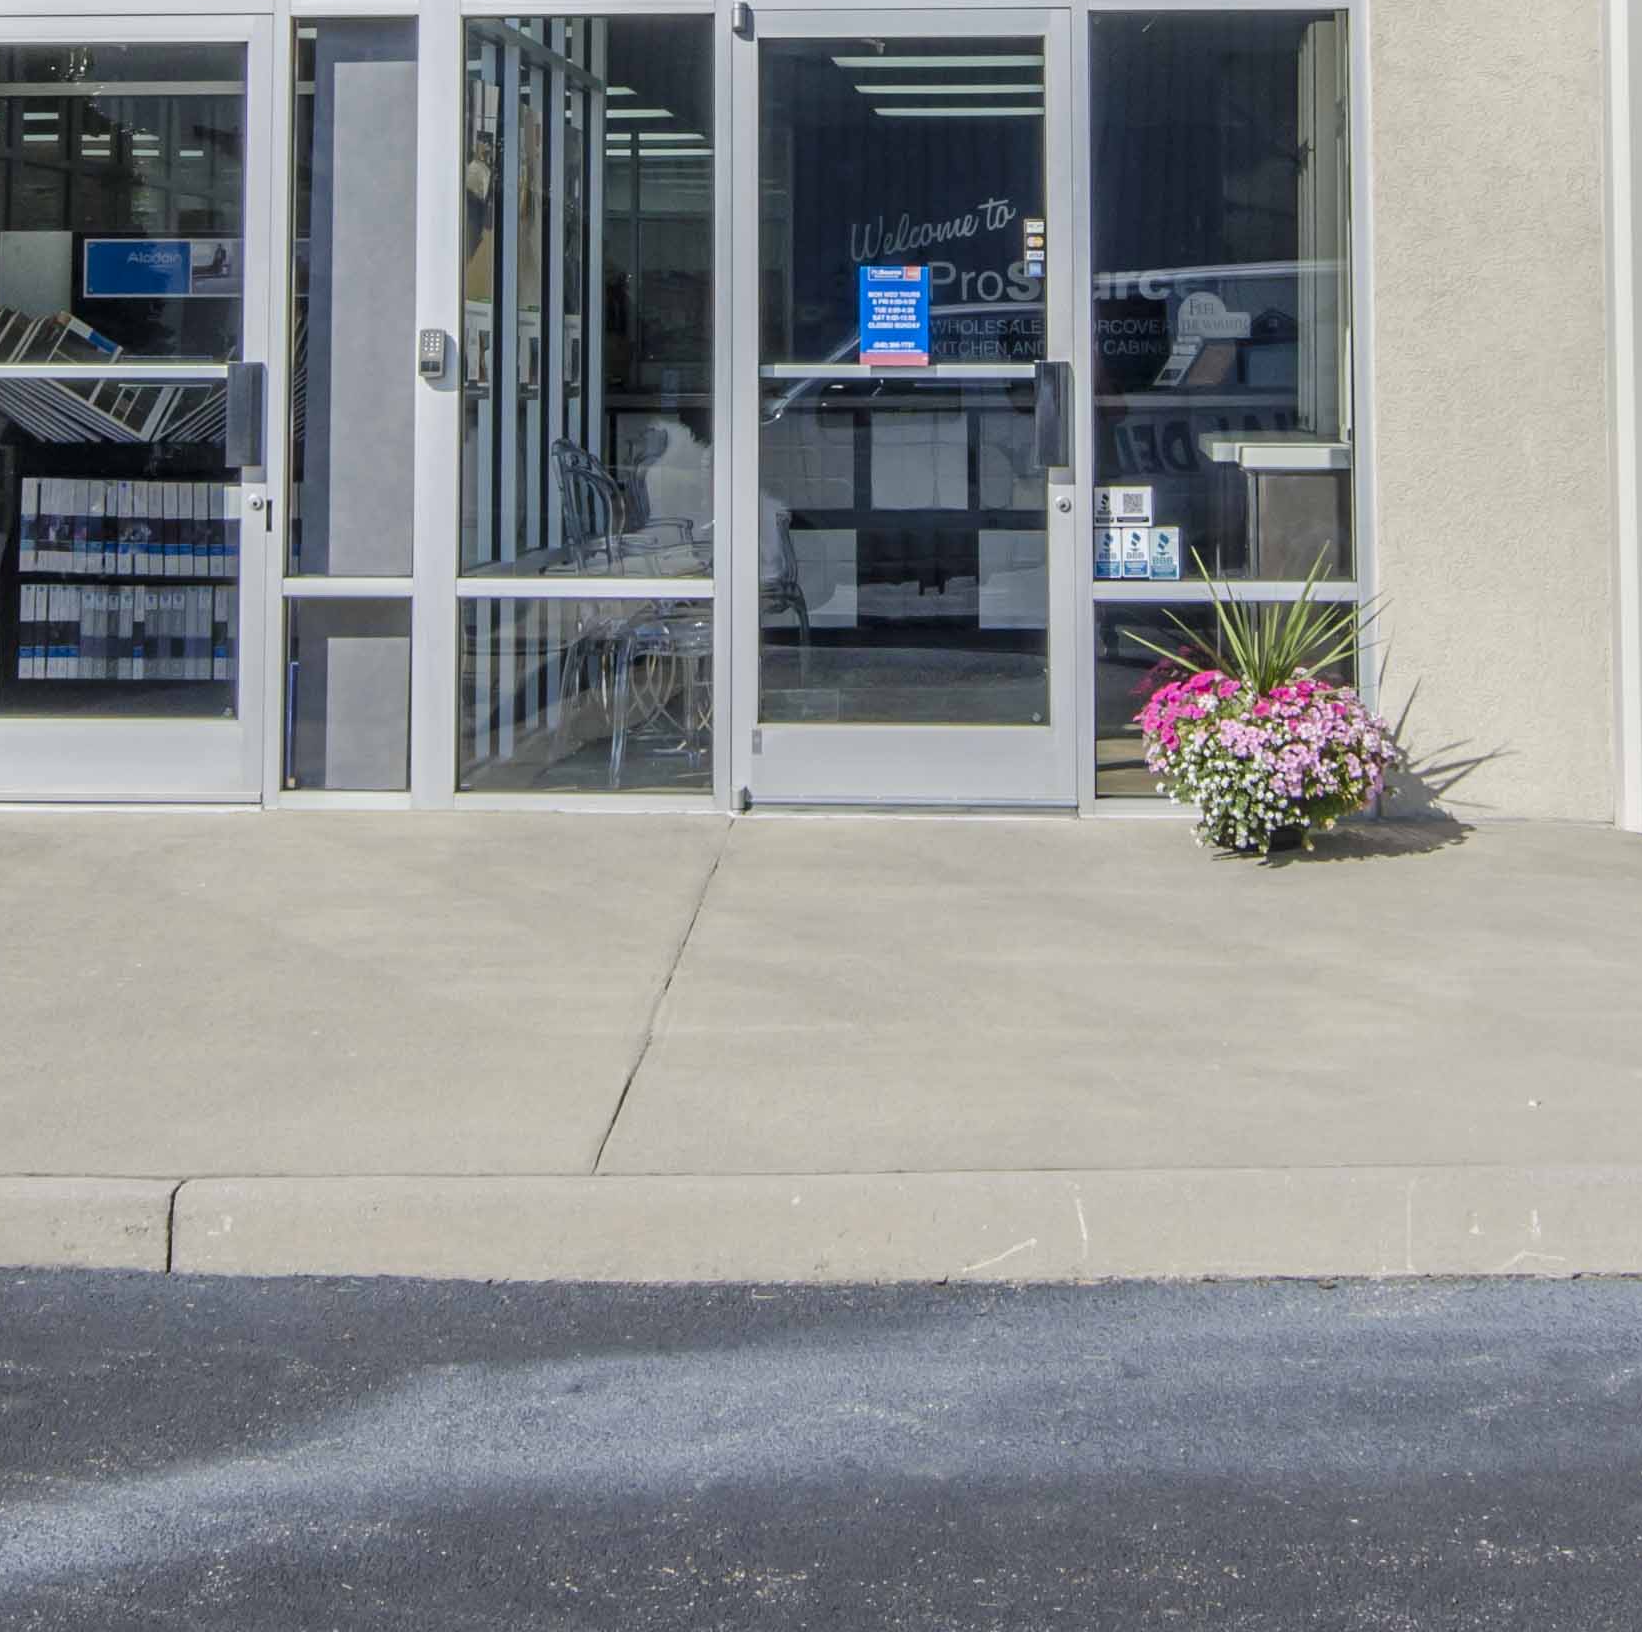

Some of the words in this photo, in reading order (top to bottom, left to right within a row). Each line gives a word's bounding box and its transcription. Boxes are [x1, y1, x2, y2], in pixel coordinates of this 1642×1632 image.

[850, 214, 979, 261] Welcome
[977, 198, 1016, 231] to
[930, 319, 1044, 335] WHOLESALE
[931, 340, 1006, 356] KITCHEN
